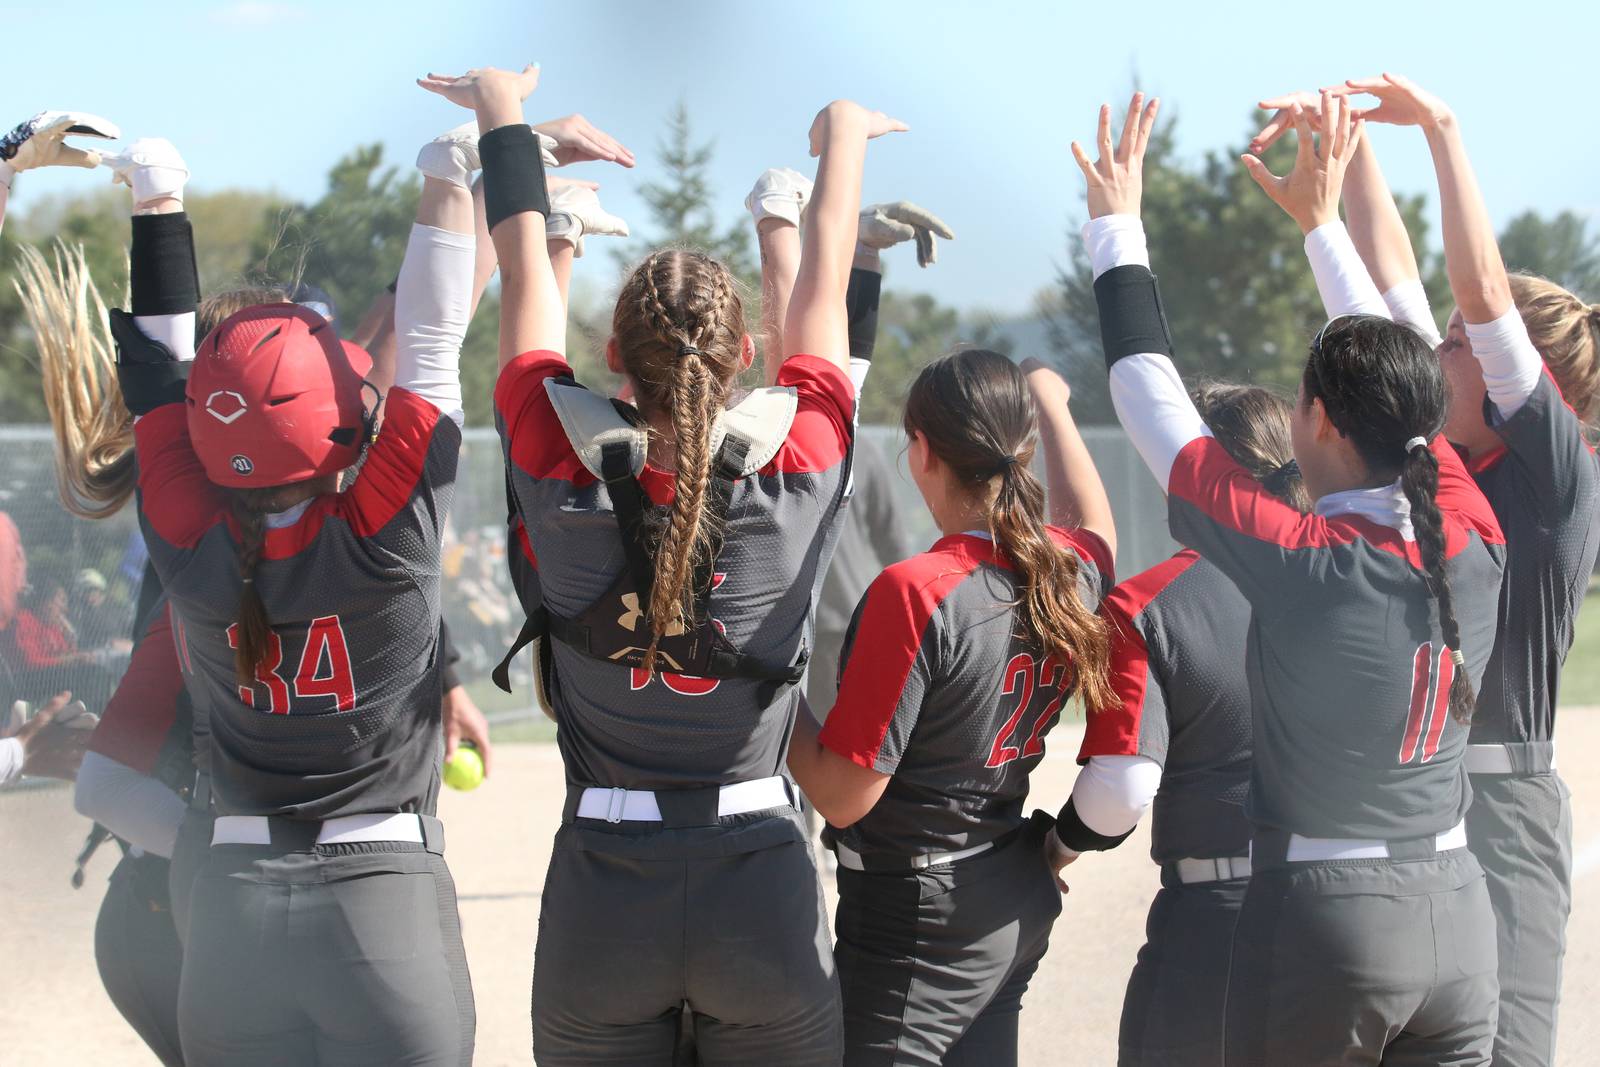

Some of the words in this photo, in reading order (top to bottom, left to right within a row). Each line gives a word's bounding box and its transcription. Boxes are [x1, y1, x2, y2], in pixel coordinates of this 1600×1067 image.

[226, 614, 356, 715] 34
[984, 652, 1073, 768] 22
[1399, 641, 1455, 764] 11
